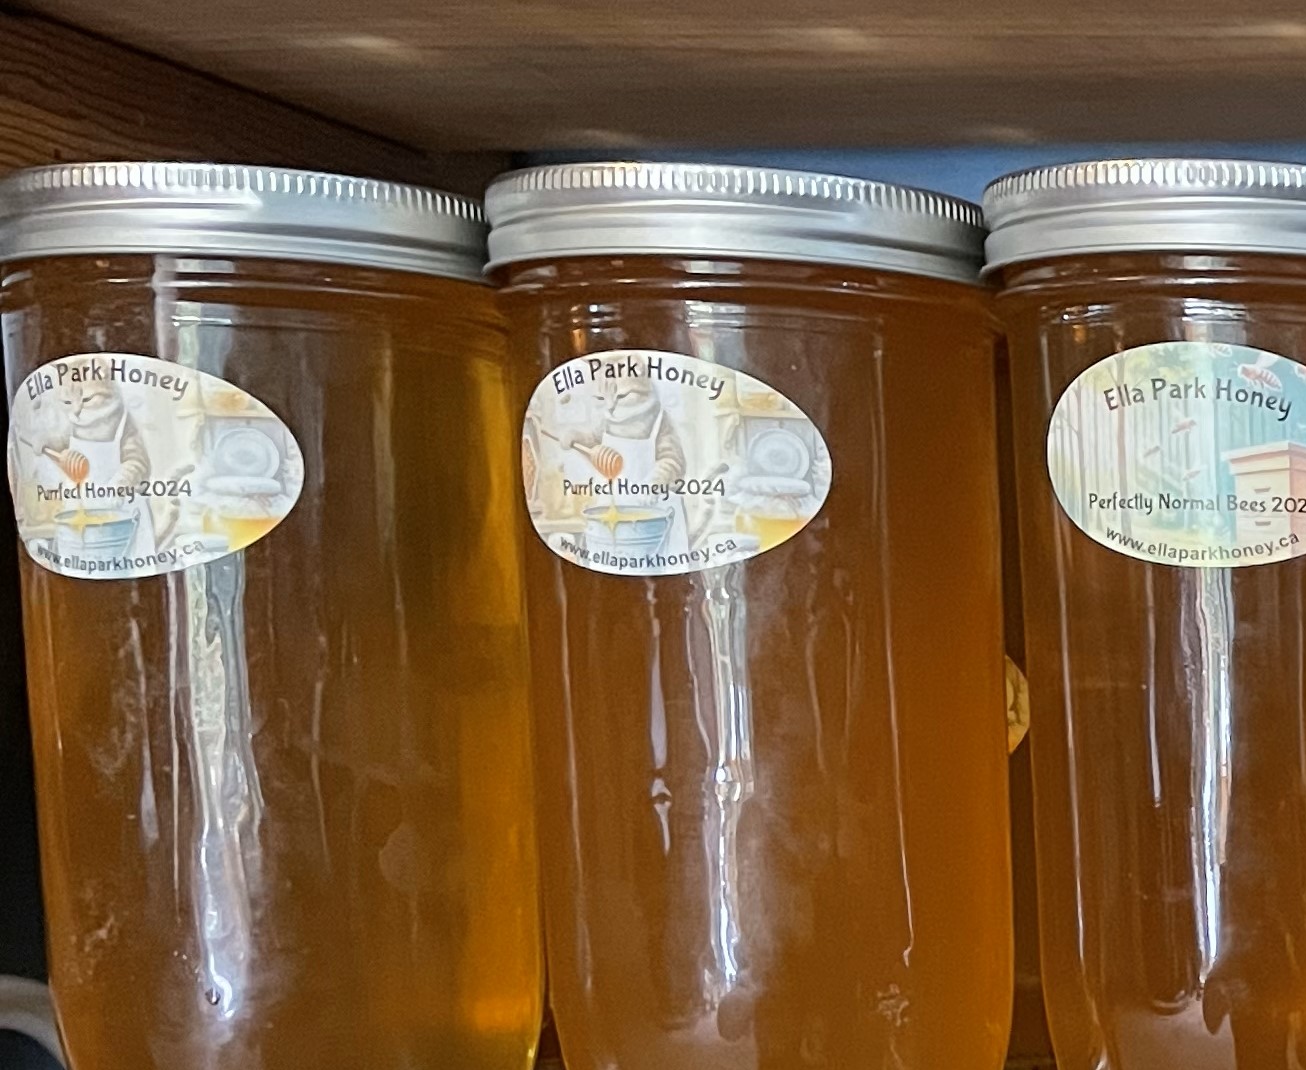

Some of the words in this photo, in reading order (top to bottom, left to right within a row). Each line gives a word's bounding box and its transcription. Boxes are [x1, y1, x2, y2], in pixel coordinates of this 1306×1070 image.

[26, 373, 53, 400] Ella
[57, 361, 101, 386] Park
[110, 359, 188, 400] Honey
[553, 368, 584, 395] Ella
[589, 357, 638, 381] Park
[647, 357, 725, 400] Honey
[1103, 385, 1144, 411] Ella
[1151, 378, 1205, 401] Park
[1216, 378, 1292, 422] Honey
[37, 483, 81, 501] Purrfect
[86, 483, 135, 503] Honey
[140, 481, 192, 497] 2024
[564, 479, 611, 497] Purrfect
[618, 479, 669, 500] Honey
[674, 479, 725, 496] 2024
[1089, 492, 1152, 515] Perfectly
[1159, 494, 1219, 511] Normal
[1227, 494, 1266, 513] Bees
[37, 539, 204, 574] www.ellaparkhoney.ca
[560, 536, 737, 570] www.ellaparkhoney.ca
[1107, 527, 1299, 562] www.ellaparkhoney.ca
